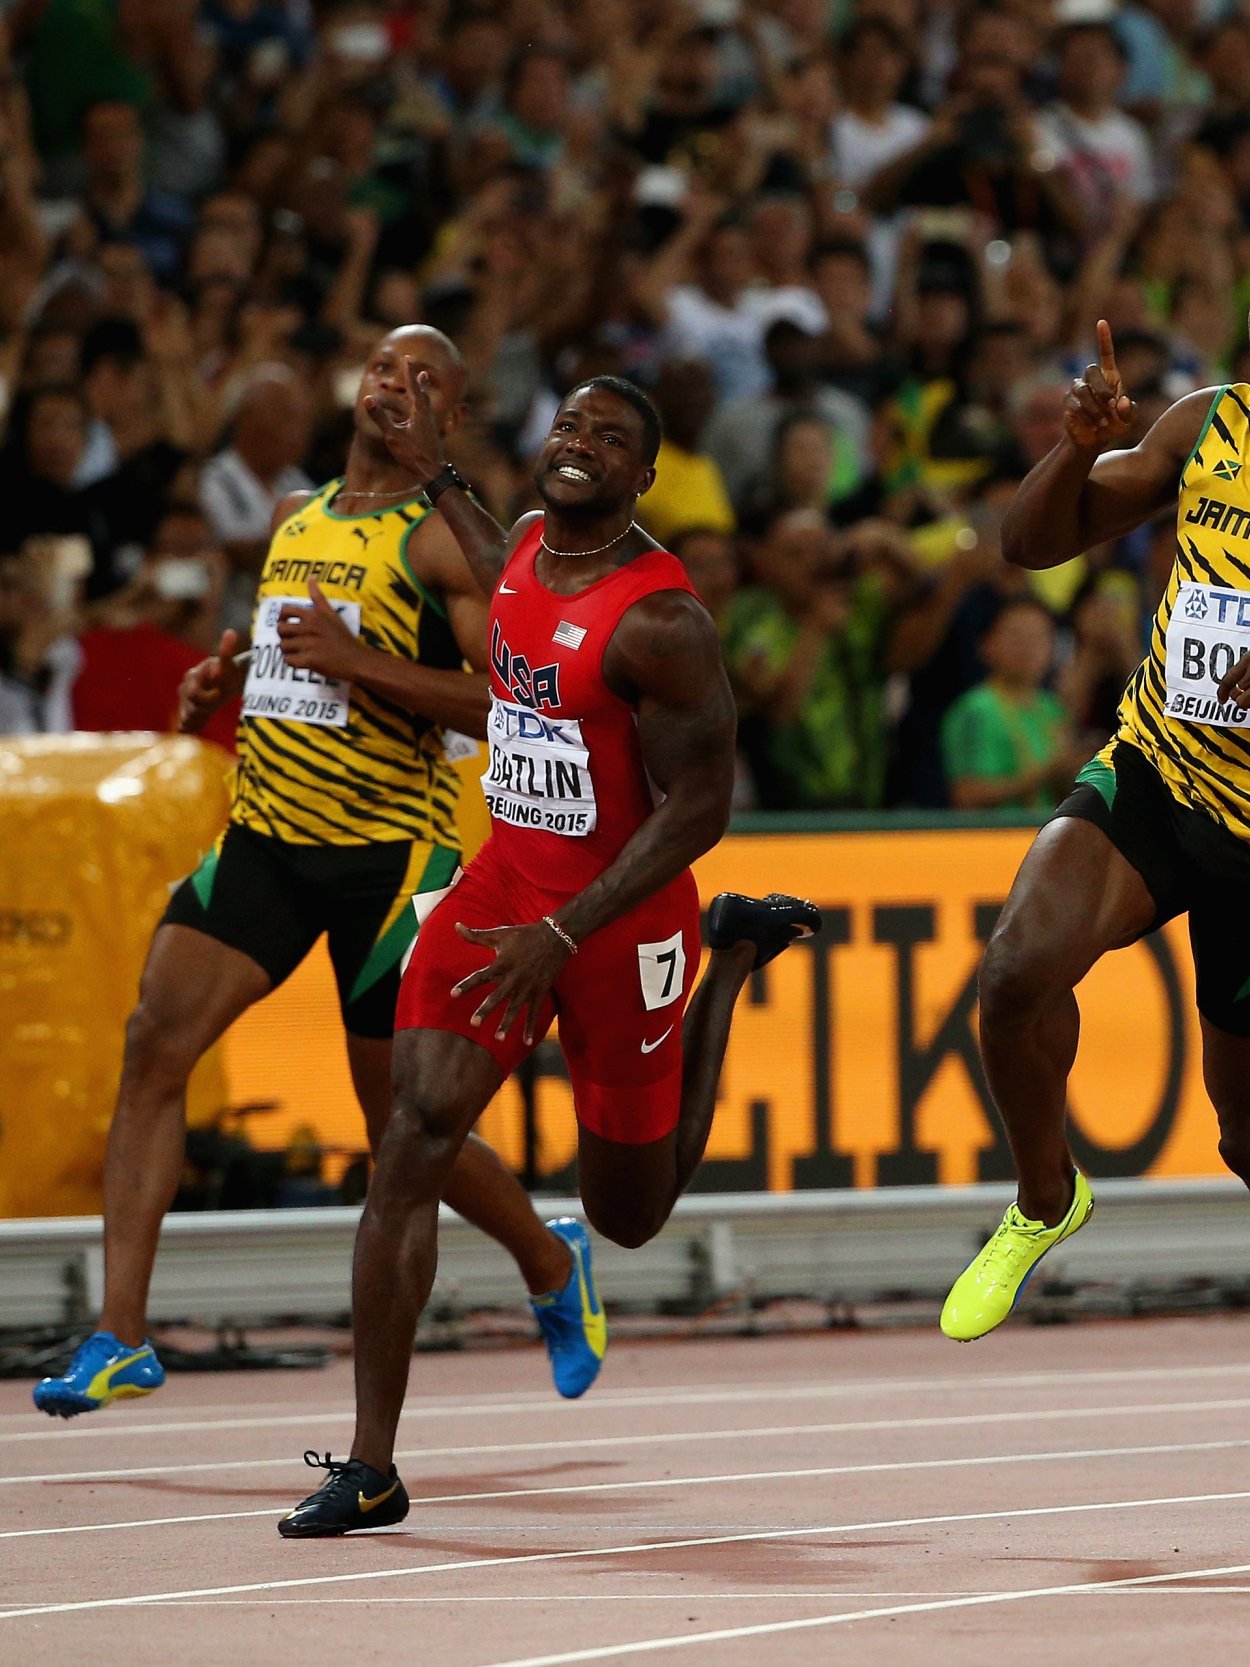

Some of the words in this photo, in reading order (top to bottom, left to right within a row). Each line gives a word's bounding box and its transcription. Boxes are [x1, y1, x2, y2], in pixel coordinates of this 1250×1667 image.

[490, 618, 562, 711] USA
[294, 699, 340, 719] 2015
[502, 704, 574, 745] TDK
[1169, 693, 1247, 724] BEIJING
[489, 743, 583, 799] GATLIN
[545, 812, 588, 832] 2015
[656, 947, 677, 998] 7
